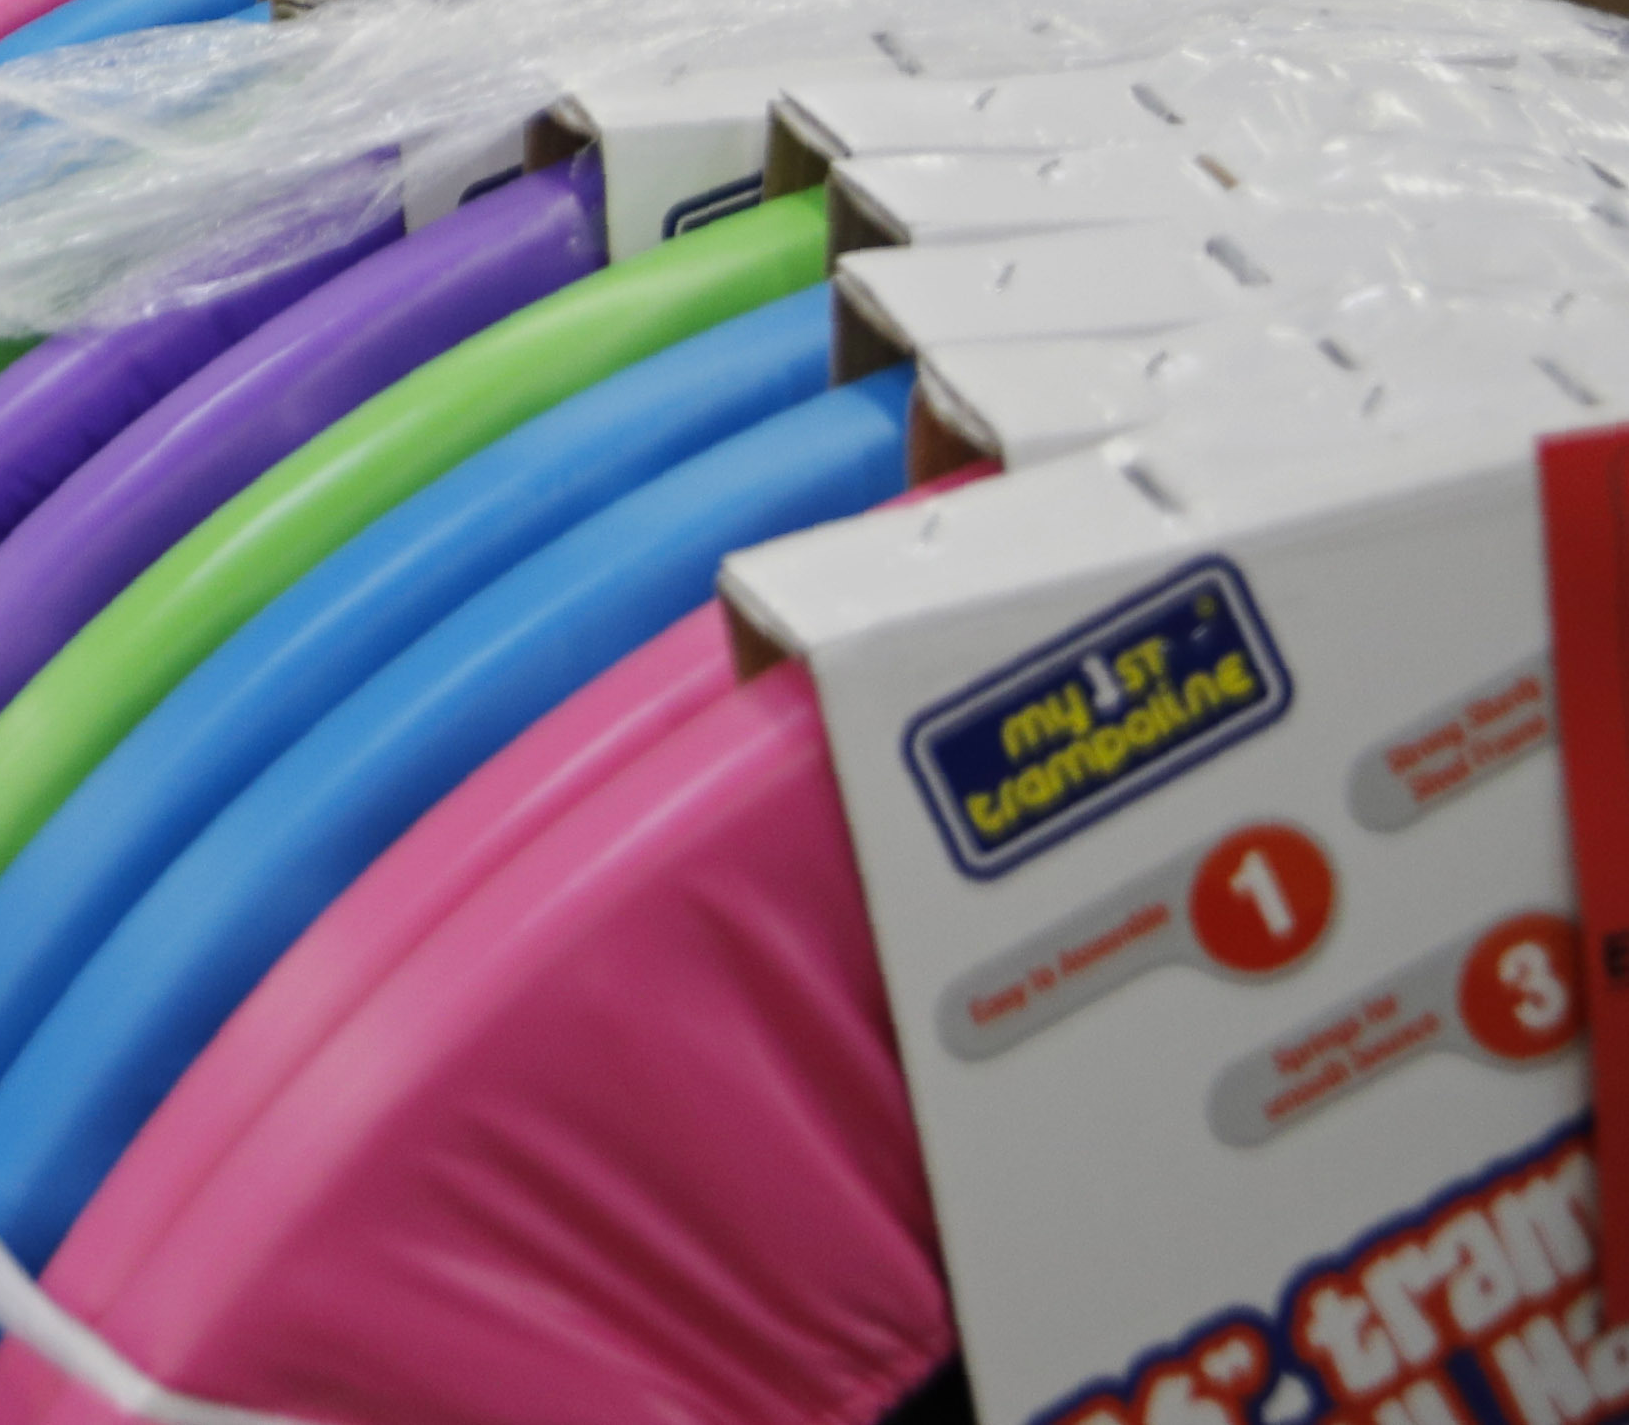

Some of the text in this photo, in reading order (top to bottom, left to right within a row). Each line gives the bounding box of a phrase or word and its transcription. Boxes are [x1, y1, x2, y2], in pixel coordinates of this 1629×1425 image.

[965, 651, 1255, 835] trampoline
[1000, 682, 1092, 763] my
[1227, 847, 1298, 941] 1
[1497, 939, 1568, 1031] 3
